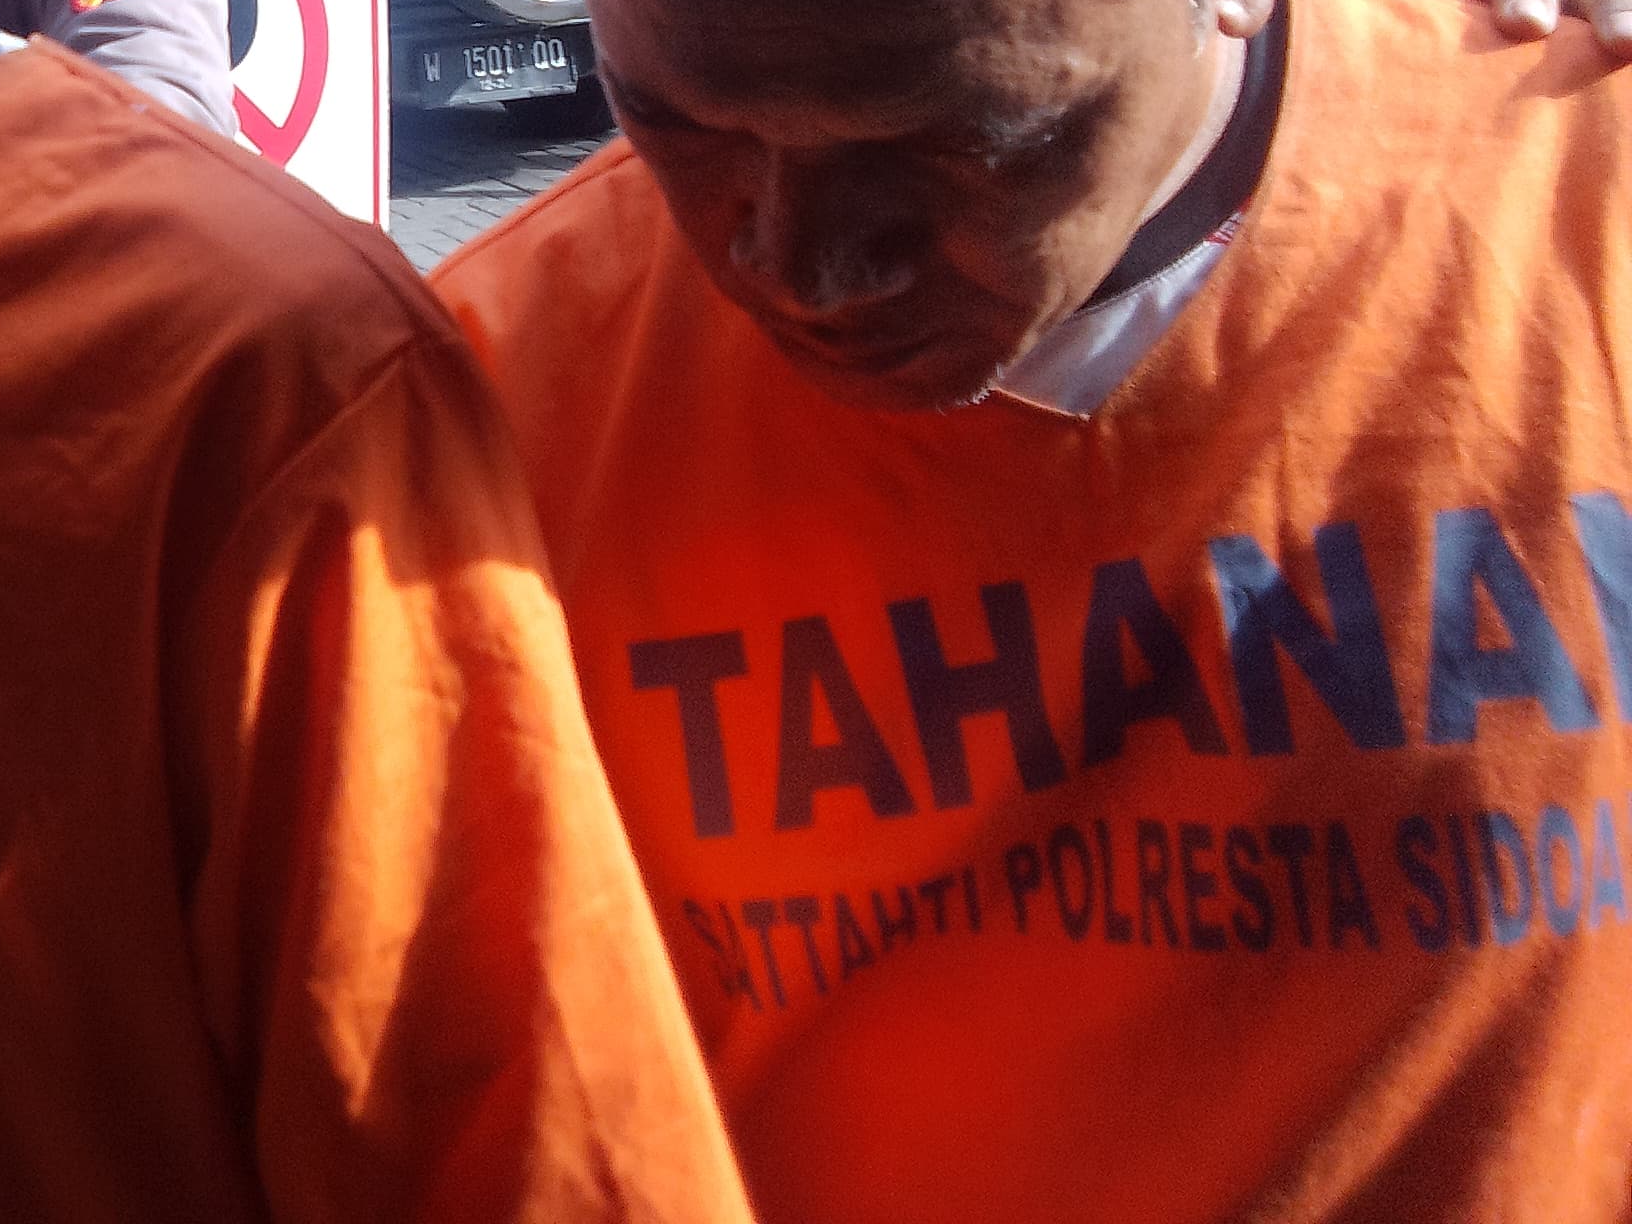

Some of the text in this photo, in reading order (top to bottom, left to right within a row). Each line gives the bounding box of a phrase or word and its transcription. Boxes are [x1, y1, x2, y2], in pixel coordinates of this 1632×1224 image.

[463, 43, 515, 79] 1501
[1003, 816, 1380, 956] POLRESTA
[1396, 790, 1632, 954] SIDOA
